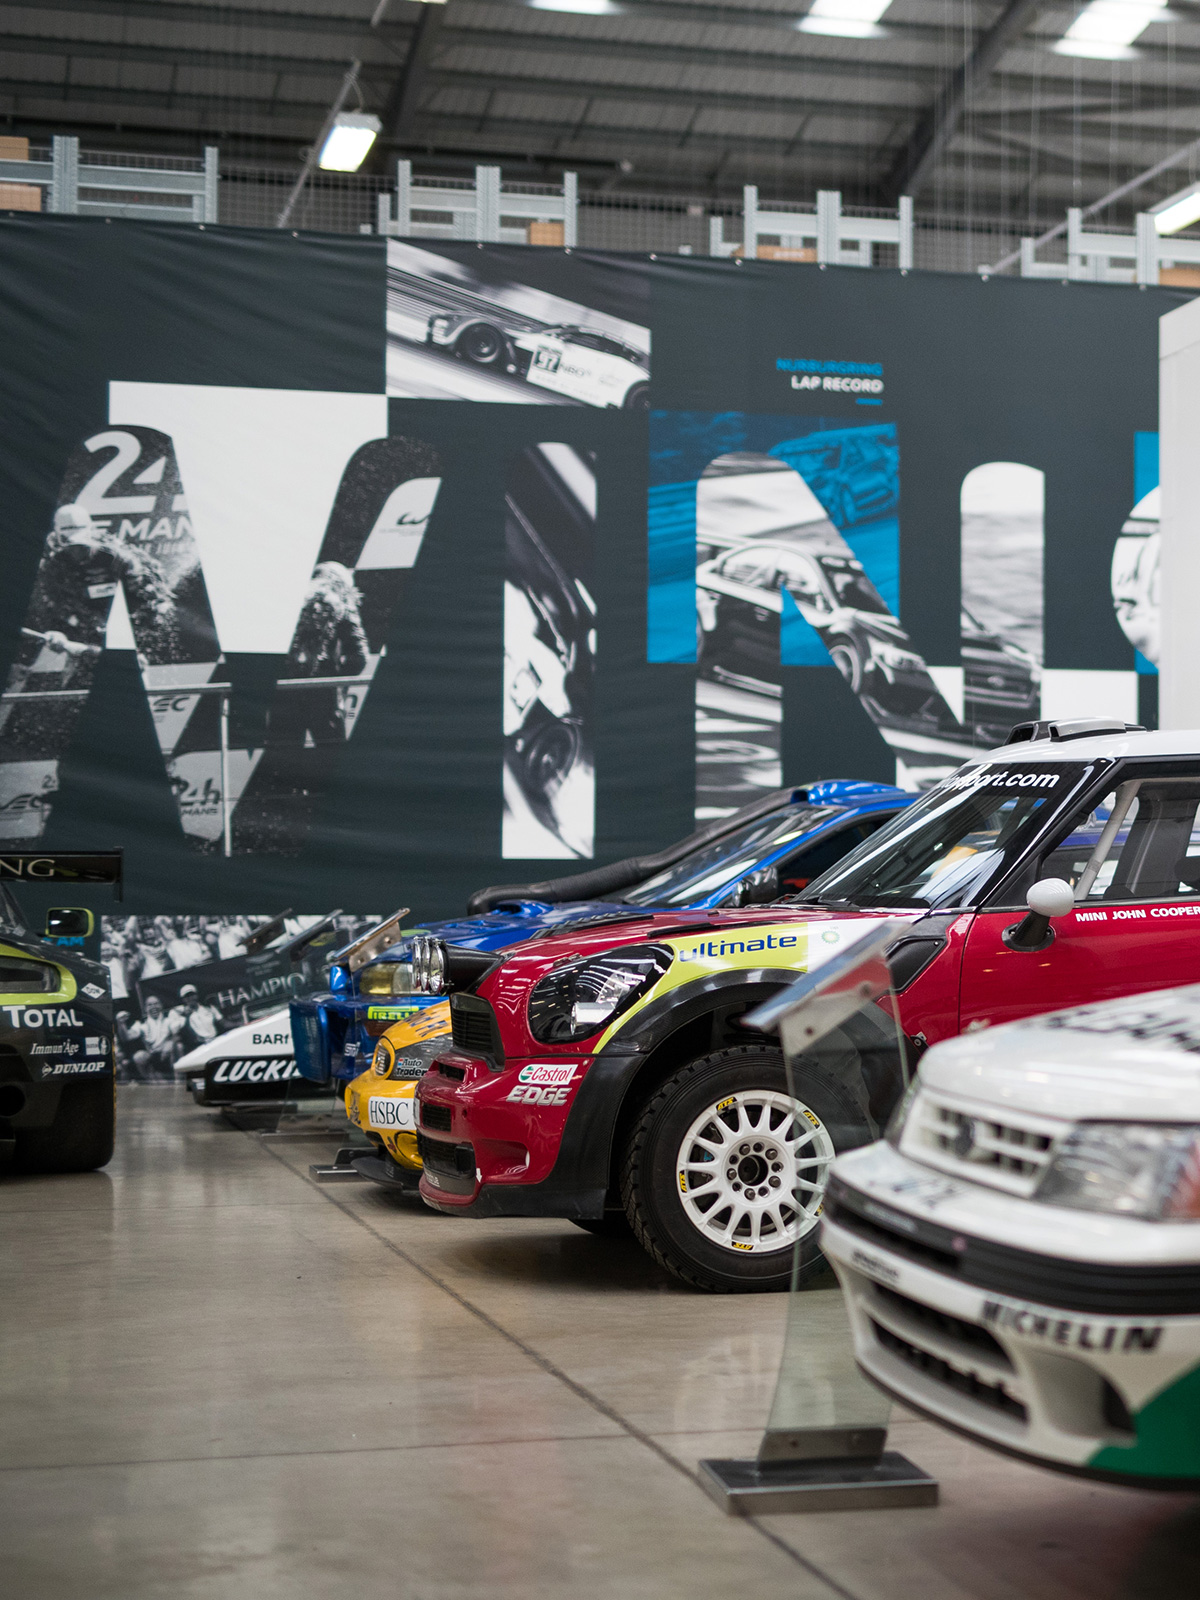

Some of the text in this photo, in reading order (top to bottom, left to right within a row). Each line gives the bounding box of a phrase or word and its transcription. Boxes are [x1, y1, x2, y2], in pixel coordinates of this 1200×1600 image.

[791, 375, 884, 394] LAP RECORD
[1075, 911, 1107, 922] MINI
[1112, 909, 1146, 920] JOHN
[679, 934, 797, 962] ultimate
[52, 1061, 106, 1075] DUNLOP
[402, 1058, 422, 1067] Auto
[531, 1065, 572, 1081] Castrol
[506, 1085, 573, 1106] EDGE
[370, 1100, 409, 1126] HSBC
